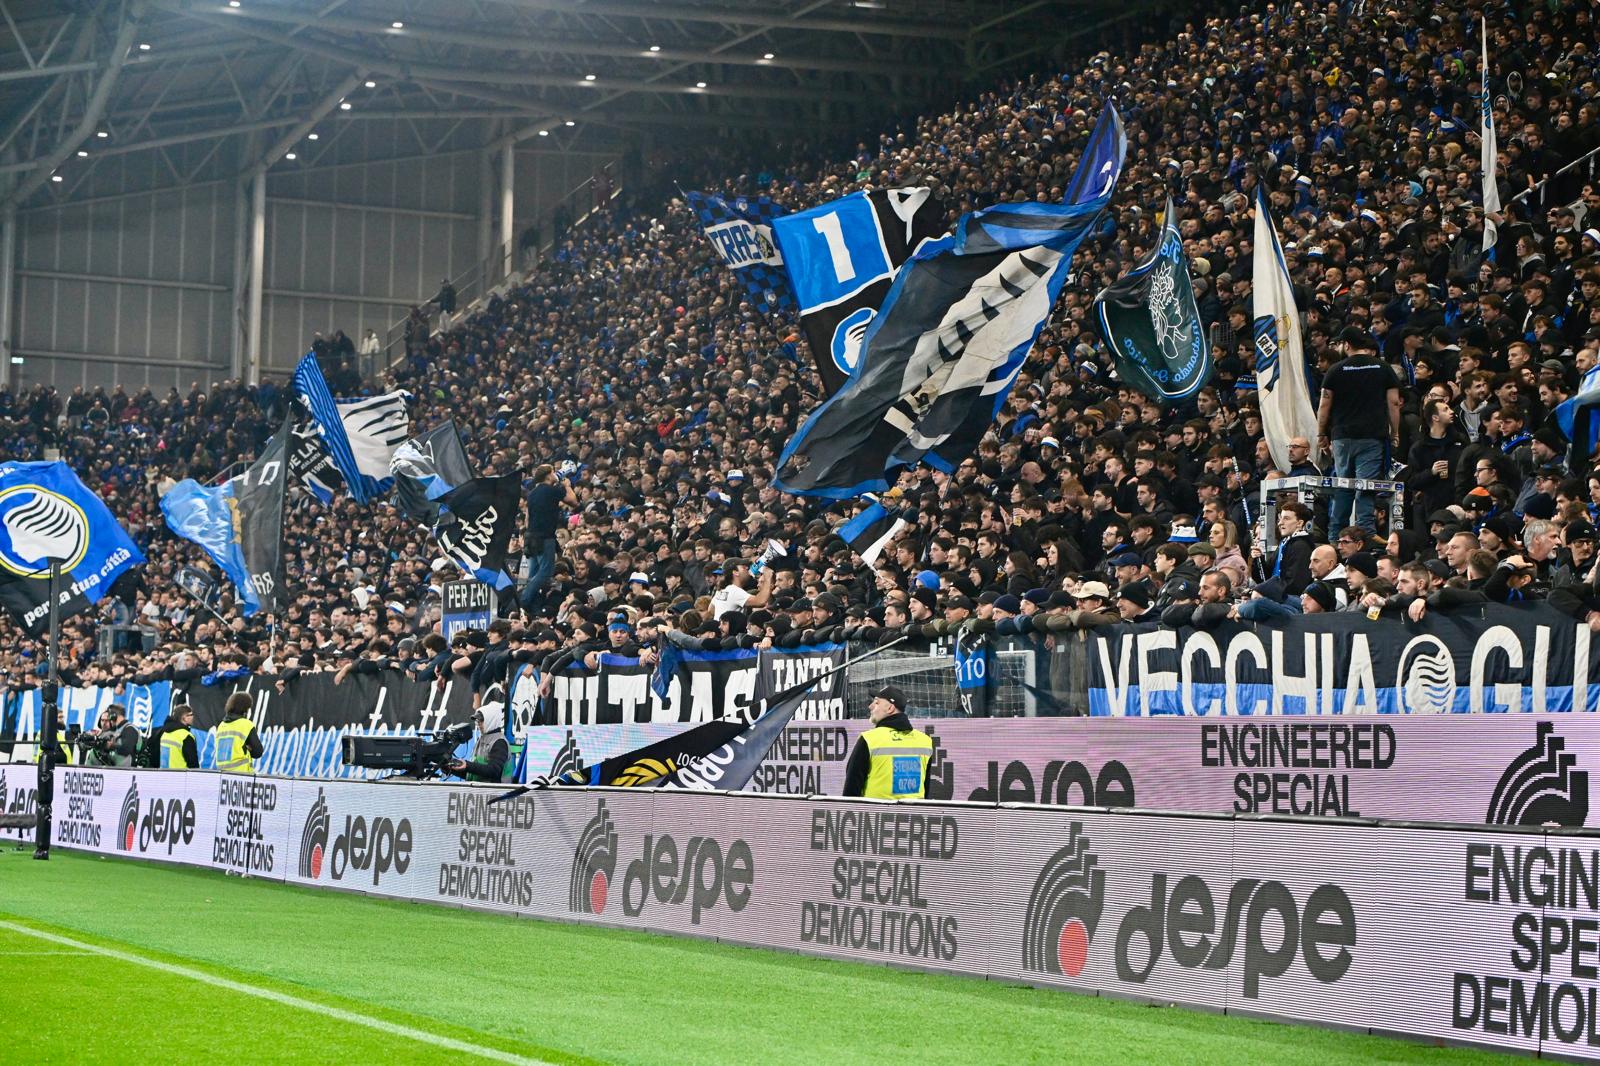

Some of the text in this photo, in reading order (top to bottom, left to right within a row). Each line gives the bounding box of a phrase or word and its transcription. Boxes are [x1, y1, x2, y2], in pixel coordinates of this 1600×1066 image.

[70, 573, 101, 596] tua
[448, 583, 468, 609] PER
[772, 656, 833, 693] TANTO
[1096, 629, 1377, 717] VECCHIA
[1201, 723, 1397, 770] ENGINEERED
[63, 771, 104, 797] ENGINEERED
[219, 779, 277, 811] ENGINEERED
[752, 764, 828, 796] SPECIAL
[1233, 772, 1361, 818] SPECIAL
[67, 796, 94, 821] SPECIAL
[139, 797, 196, 856] despe
[226, 810, 264, 841] SPECIAL
[447, 791, 535, 830] ENGINEERED
[57, 819, 102, 848] DEMOLITIONS
[330, 814, 413, 886] despe
[458, 828, 516, 866] SPECIAL
[810, 808, 959, 860] ENGINEERED
[212, 837, 275, 873] DEMOLITIONS
[438, 863, 533, 907] DEMOLITIONS
[622, 833, 755, 925] despe
[831, 856, 928, 909] SPECIAL
[800, 901, 958, 961] DEMOLITIONS
[1114, 872, 1357, 1000] despe
